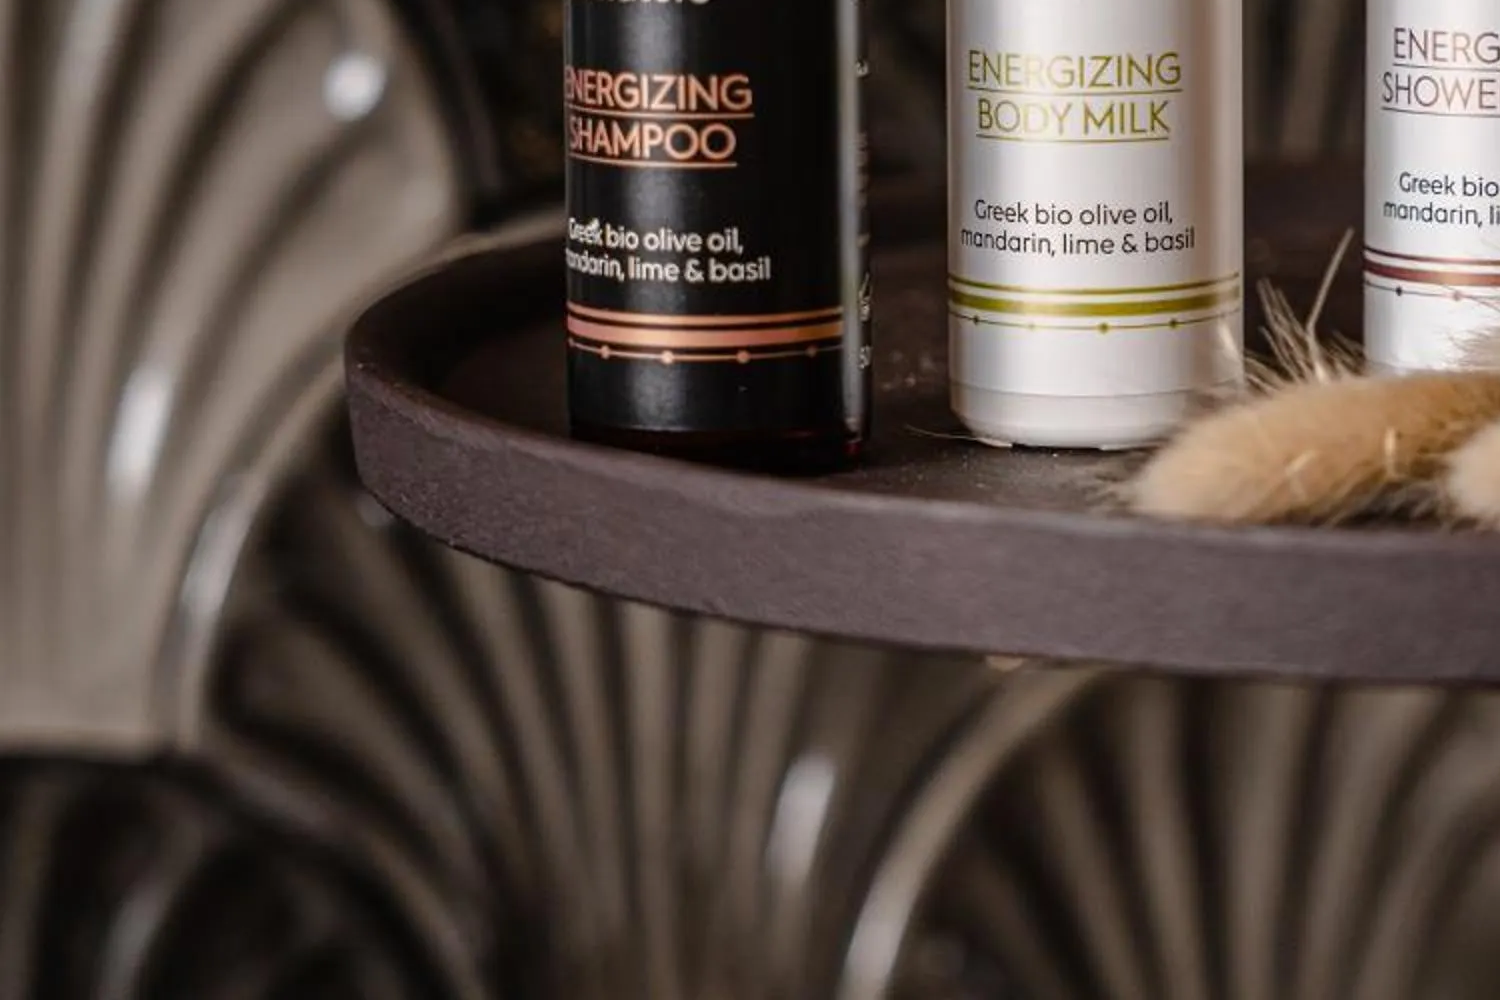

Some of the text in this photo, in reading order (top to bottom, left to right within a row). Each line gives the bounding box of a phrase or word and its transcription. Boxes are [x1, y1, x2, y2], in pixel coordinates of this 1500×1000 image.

[968, 50, 1182, 89] ENERGIZING
[978, 97, 1171, 136] BODY MILK
[569, 116, 737, 161] SHAMPOO
[1399, 171, 1456, 196] Greek
[1462, 175, 1500, 198] bio
[975, 199, 1174, 225] Greek bio olive oil,
[1383, 200, 1483, 228] mandarin,
[605, 224, 639, 251] bio
[643, 228, 703, 253] olive
[707, 226, 744, 255] oil,
[961, 226, 1196, 257] mandarin, lime & basil
[628, 256, 681, 283] lime
[684, 257, 705, 283] &
[709, 255, 771, 283] basil
